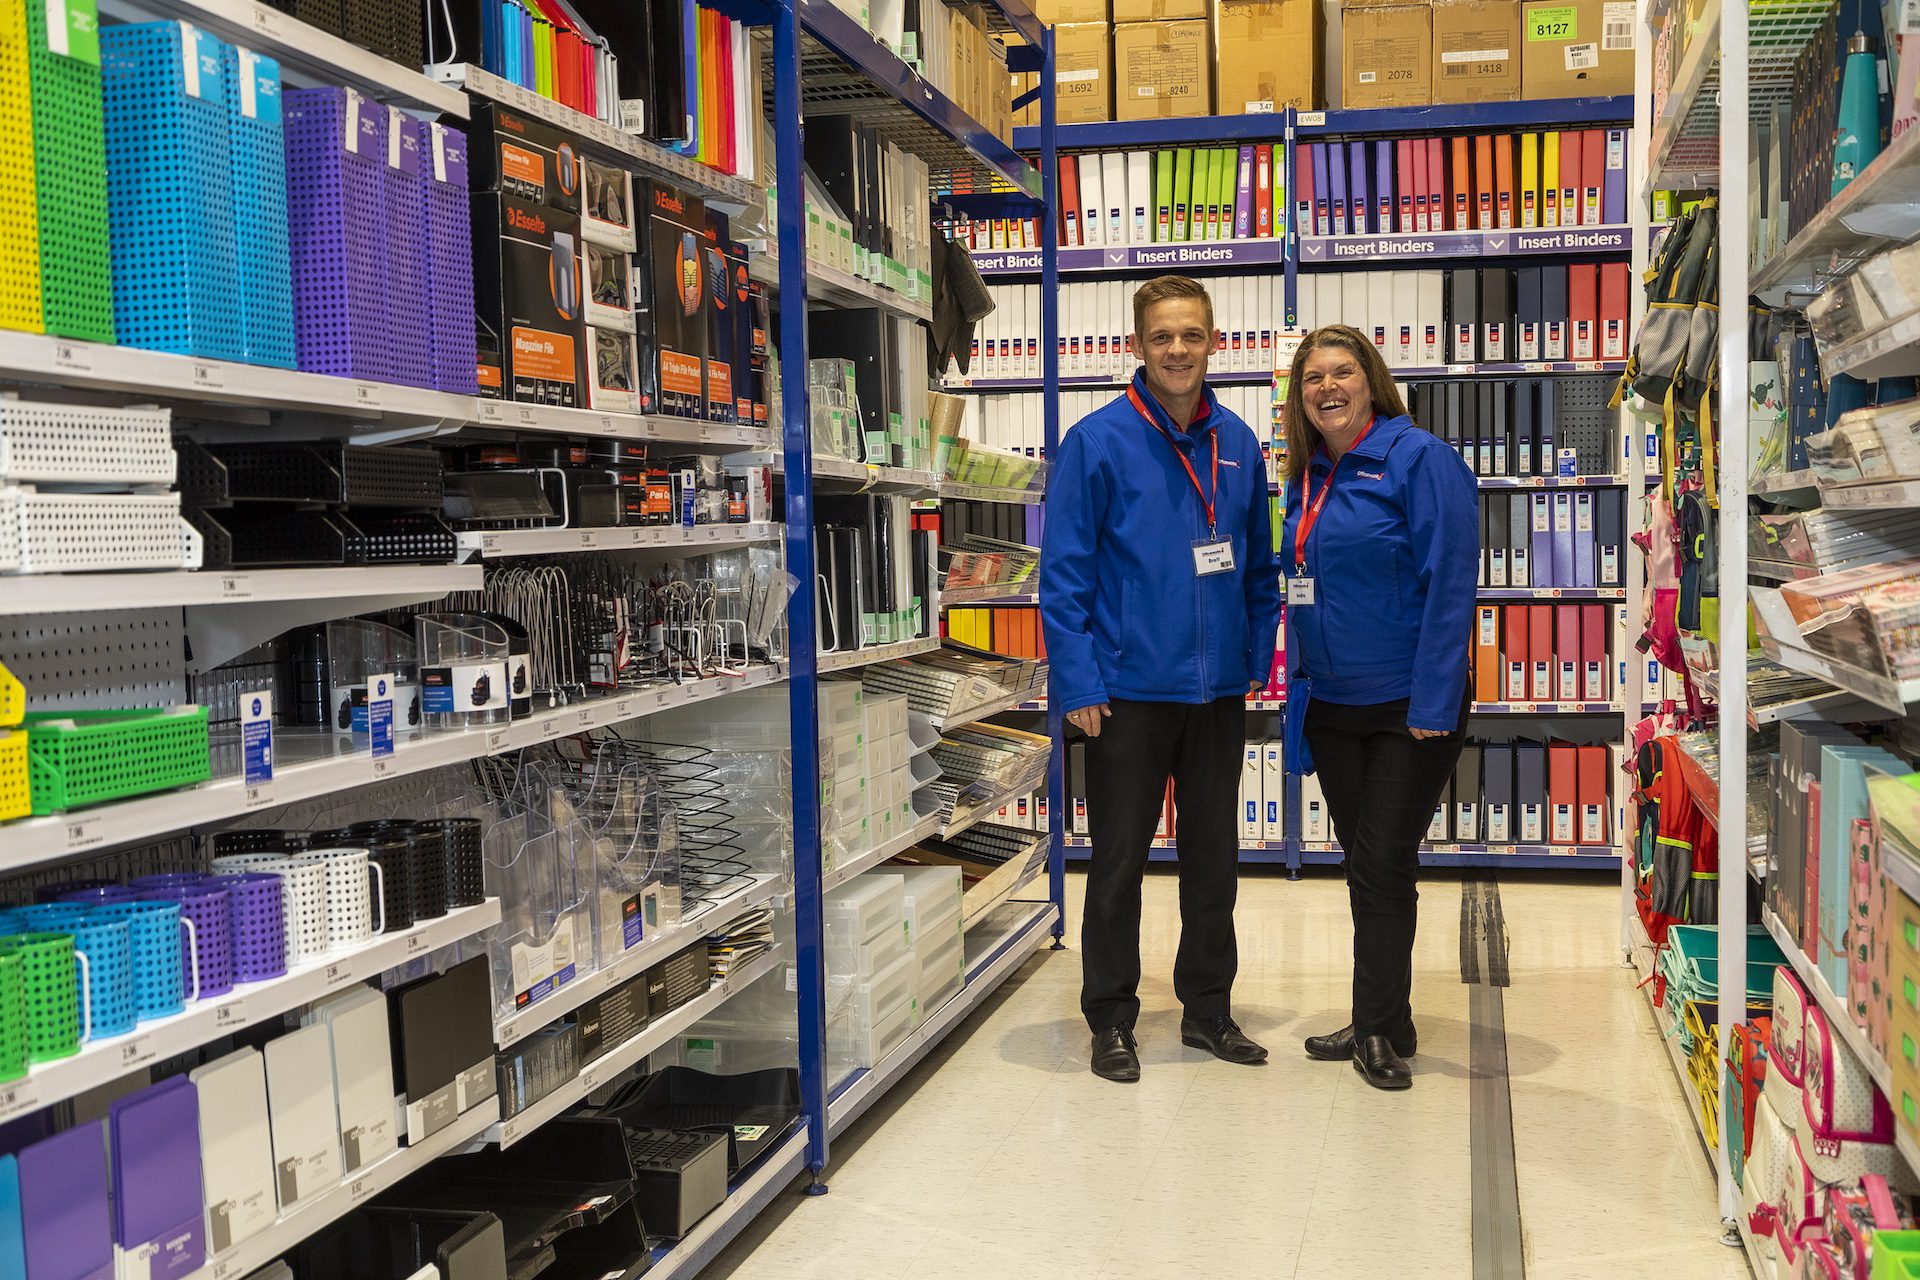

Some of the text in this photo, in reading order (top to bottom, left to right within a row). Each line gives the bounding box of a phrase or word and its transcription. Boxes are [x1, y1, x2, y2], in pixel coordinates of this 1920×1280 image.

[1221, 6, 1254, 19] 3223
[1537, 23, 1569, 36] 8127
[1388, 69, 1413, 80] 2078
[1477, 63, 1502, 74] 1418
[1069, 83, 1093, 93] 1692
[1300, 115, 1322, 123] EW08
[660, 191, 683, 215] Esselte
[515, 208, 546, 235] Esselte
[1334, 240, 1435, 255] Insert Binders
[1518, 233, 1622, 250] Insert Binders
[972, 254, 1043, 269] nsert Binde
[1136, 248, 1233, 263] Insert Binders
[515, 337, 555, 355] Magazine File
[662, 361, 670, 372] A4
[669, 363, 680, 375] Triple
[680, 364, 688, 375] File
[649, 490, 663, 500] Pen
